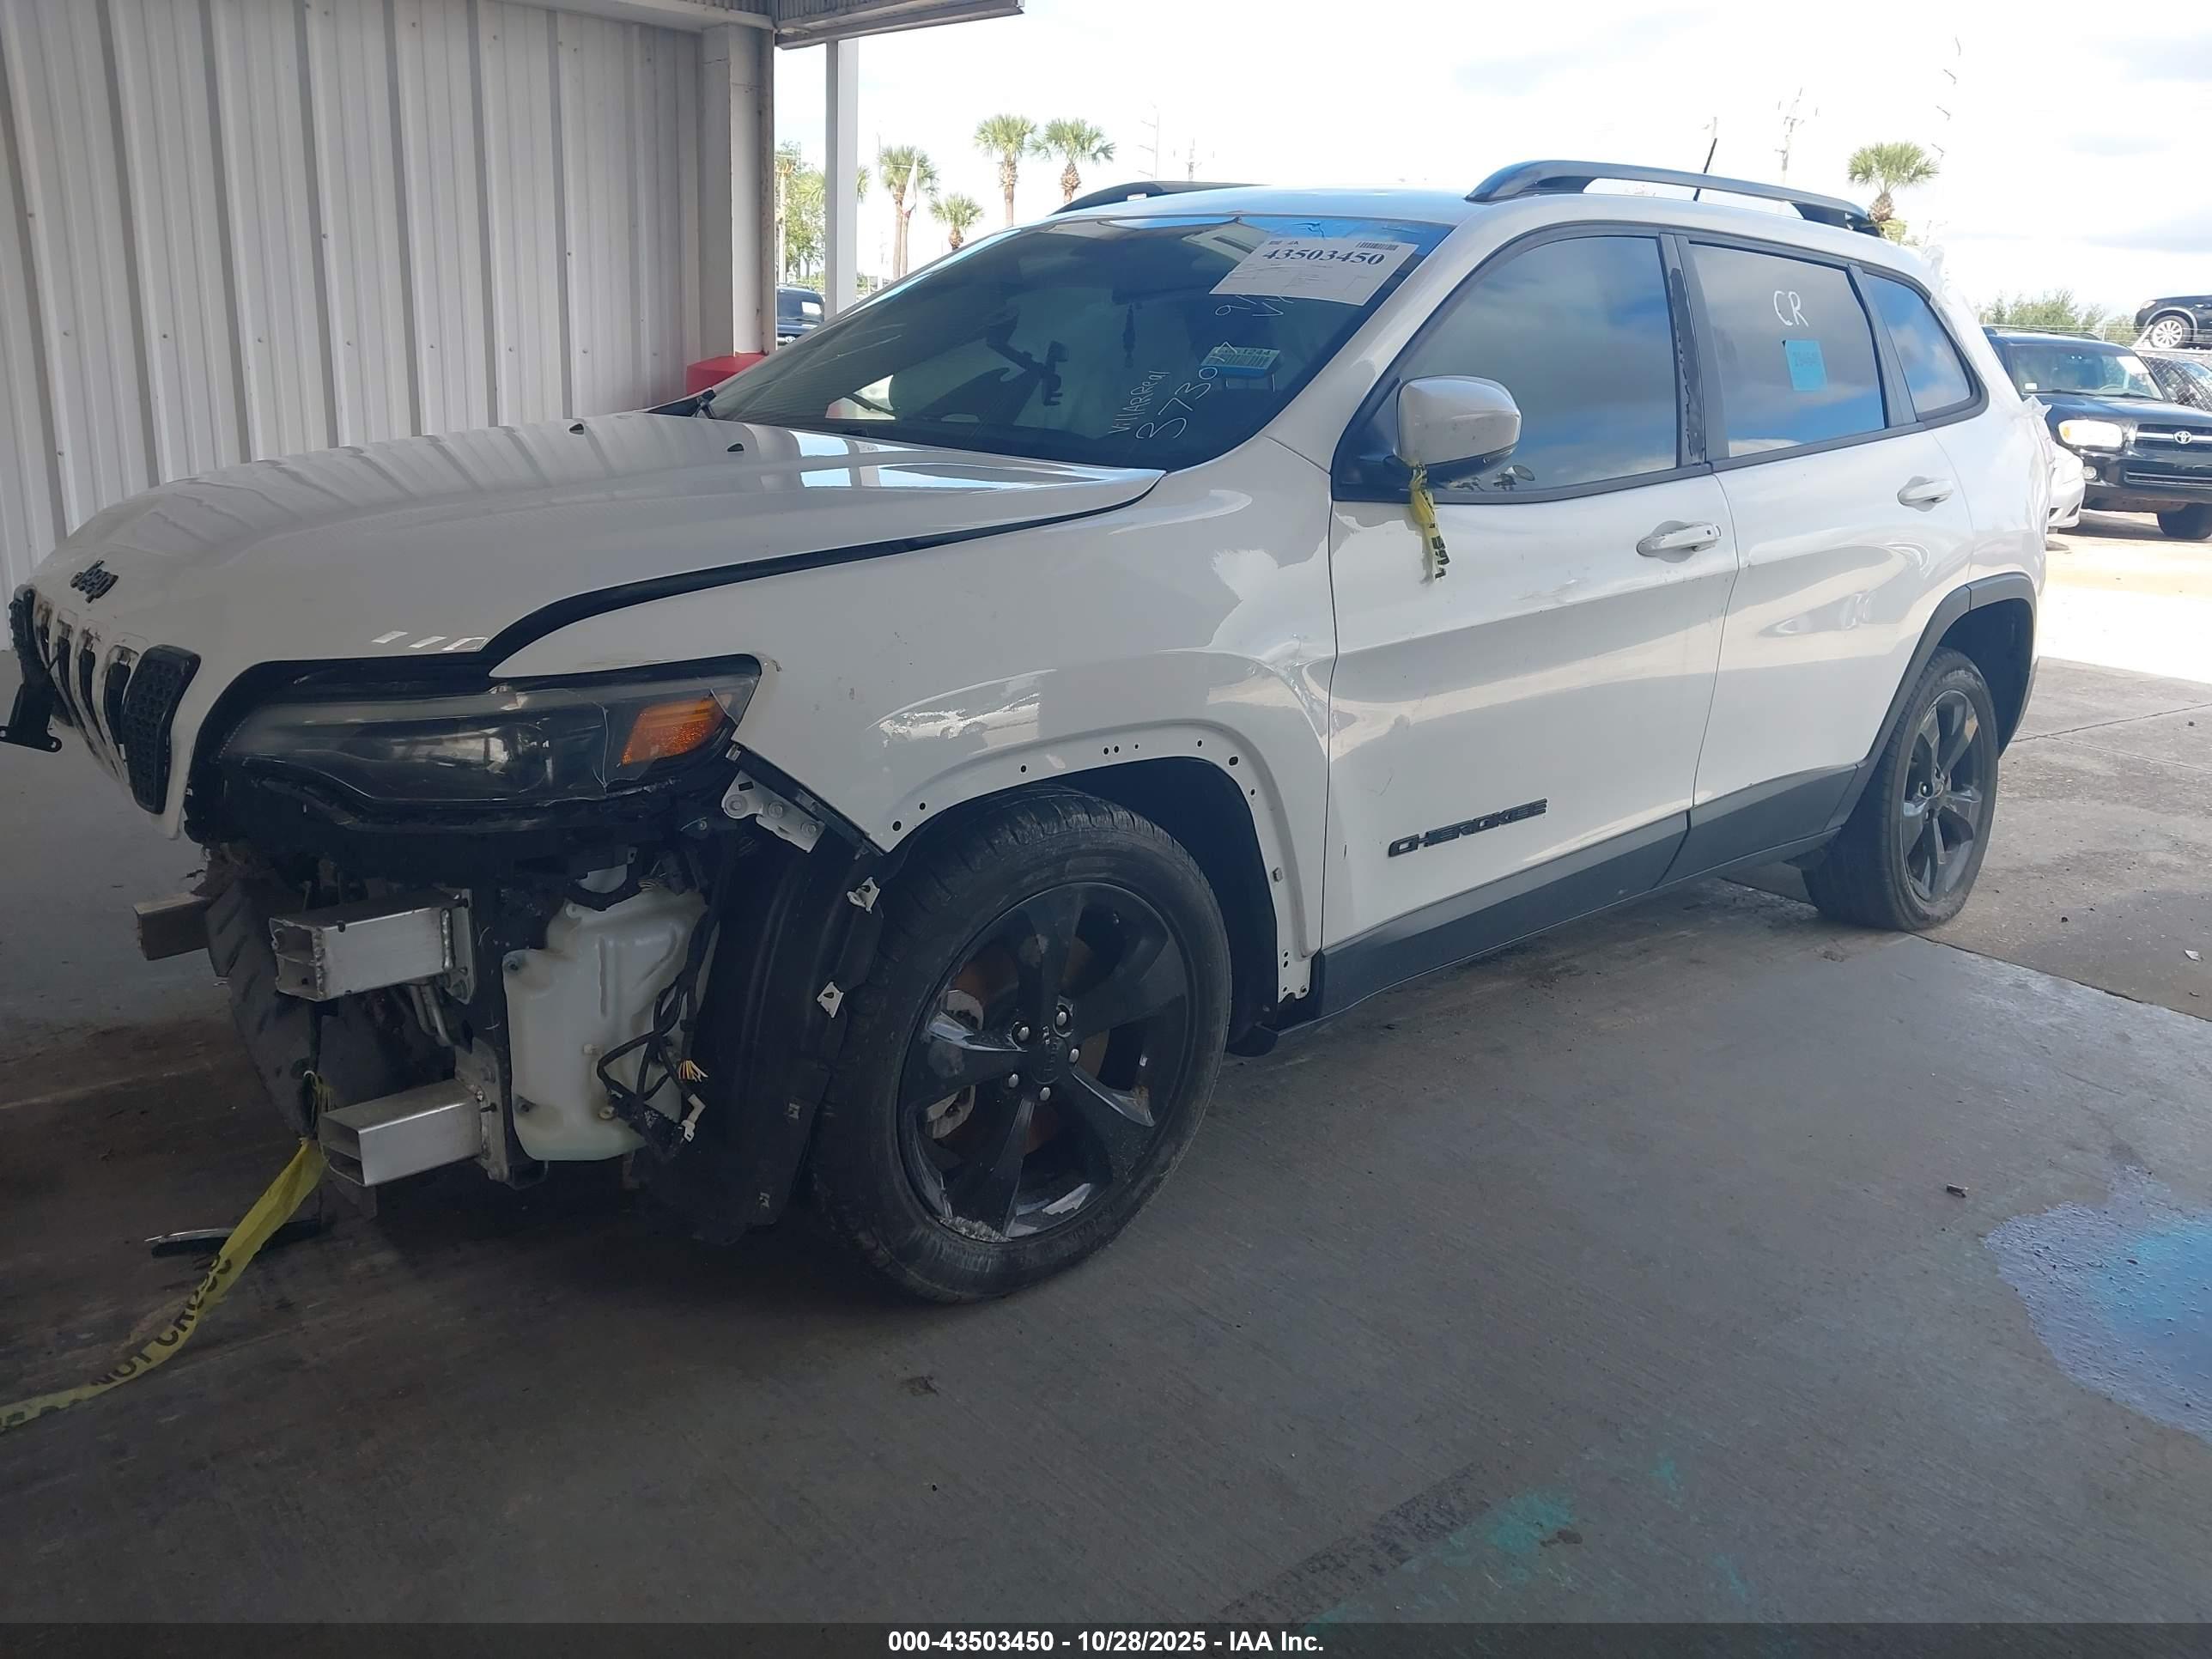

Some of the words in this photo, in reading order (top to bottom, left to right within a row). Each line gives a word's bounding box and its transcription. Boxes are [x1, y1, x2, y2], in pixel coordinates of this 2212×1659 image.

[1263, 248, 1386, 265] 43503450
[1773, 290, 1808, 327] CR
[1388, 798, 1548, 857] CHEROKEE
